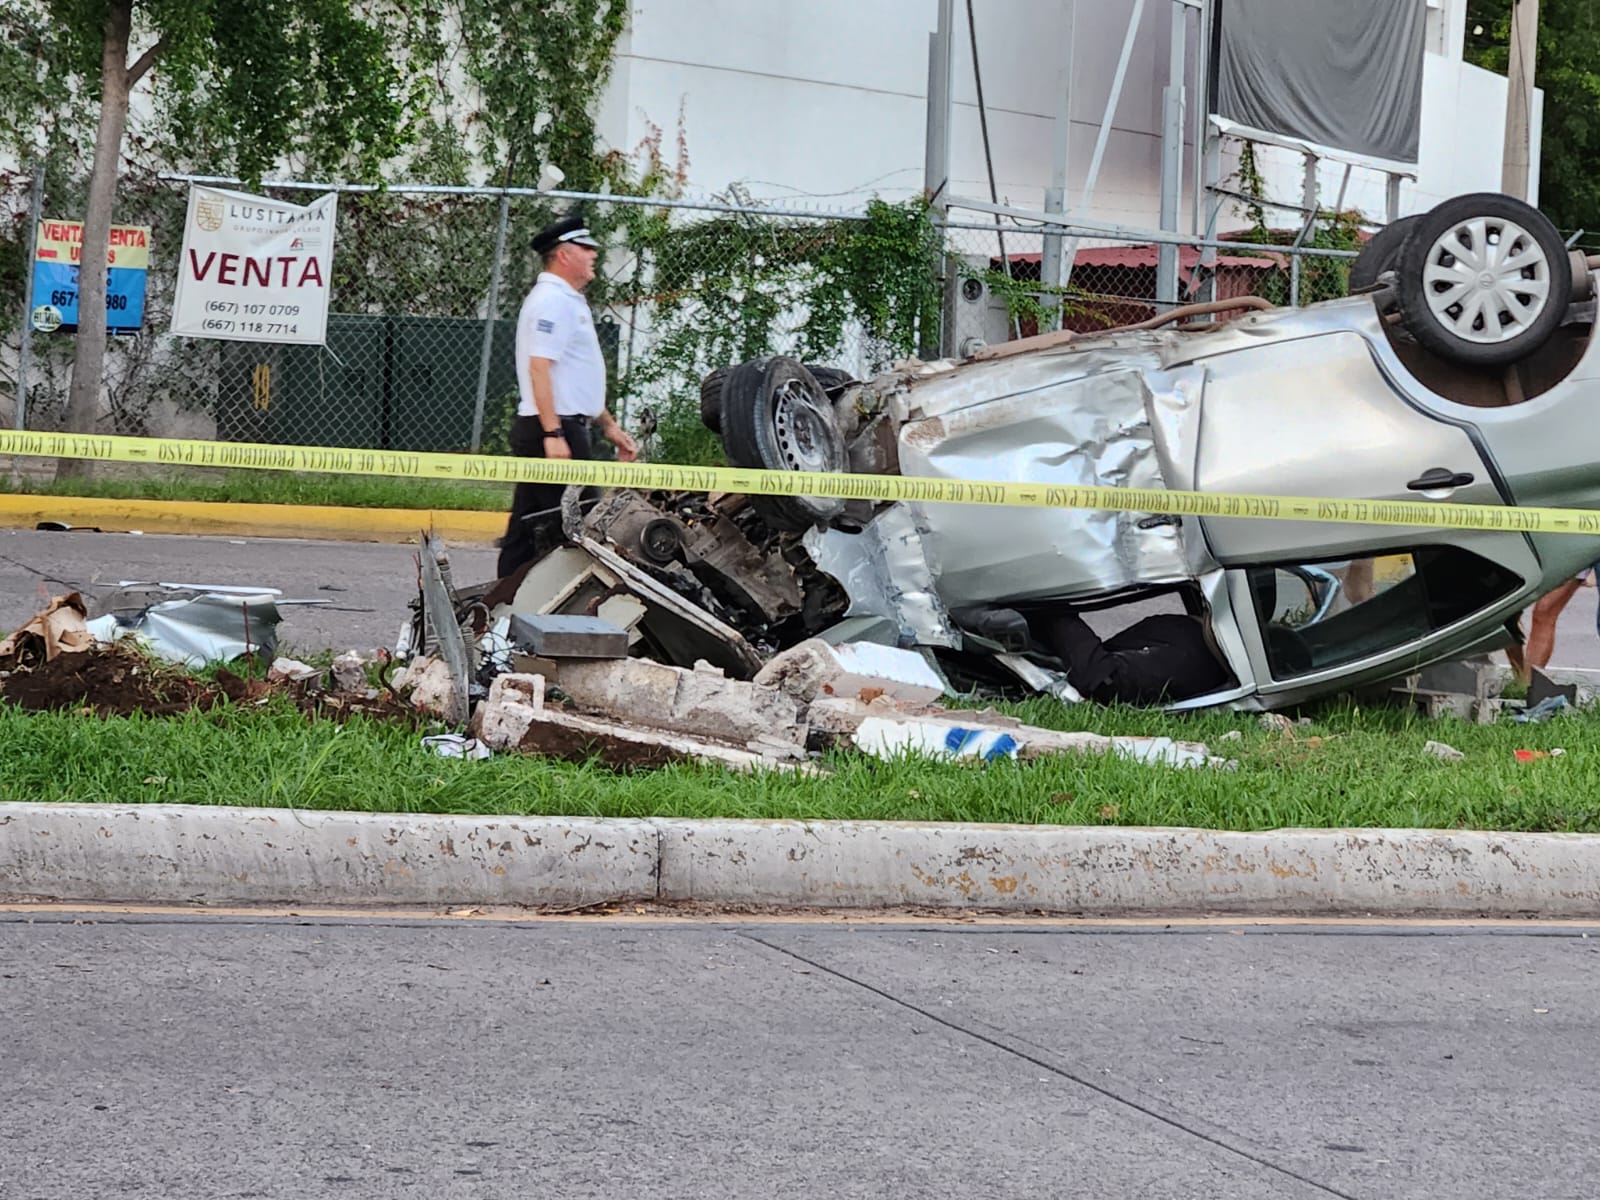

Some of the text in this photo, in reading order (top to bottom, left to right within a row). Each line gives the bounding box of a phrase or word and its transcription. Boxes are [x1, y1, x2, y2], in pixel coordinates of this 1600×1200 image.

[109, 228, 146, 248] ENTA
[188, 249, 324, 288] VENTA
[51, 290, 127, 310] 667980
[205, 300, 300, 316] (667) 107 0709
[202, 318, 297, 334] (667) 118 7714
[0, 433, 43, 452] POLICI
[47, 436, 67, 454] DE
[72, 437, 112, 457] LINEA
[158, 442, 194, 462] PASO
[199, 444, 215, 463] EL
[220, 445, 296, 467] PROHIBIDO
[301, 450, 353, 470] POLICIA
[356, 453, 375, 471] DE
[381, 454, 419, 474] LINEA
[464, 458, 498, 478] PASO
[503, 460, 519, 479] EL
[523, 461, 597, 482] PROHIBIDO
[602, 466, 651, 485] POLICIA
[655, 468, 674, 486] DE
[679, 470, 717, 488] LINEA
[760, 474, 794, 492] PASO
[798, 476, 814, 492] EL
[819, 477, 891, 496] PROHIBIDO
[895, 481, 943, 499] POLICIA
[947, 483, 964, 500] DE
[969, 485, 1006, 502] LINEA
[1046, 488, 1078, 505] PASO
[1082, 490, 1098, 506] EL
[1103, 491, 1171, 510] PROHIBIDO
[1175, 495, 1220, 512] POLICIA
[1224, 497, 1240, 513] DE
[1244, 498, 1279, 515] LINEA
[1318, 502, 1349, 519] PASO
[1353, 503, 1368, 520] EL
[1373, 504, 1436, 523] PROHIBIDO
[1439, 507, 1484, 526] POLICIA
[1487, 509, 1503, 527] DE
[1507, 510, 1540, 528] LINEA
[1577, 513, 1600, 531] ASO
